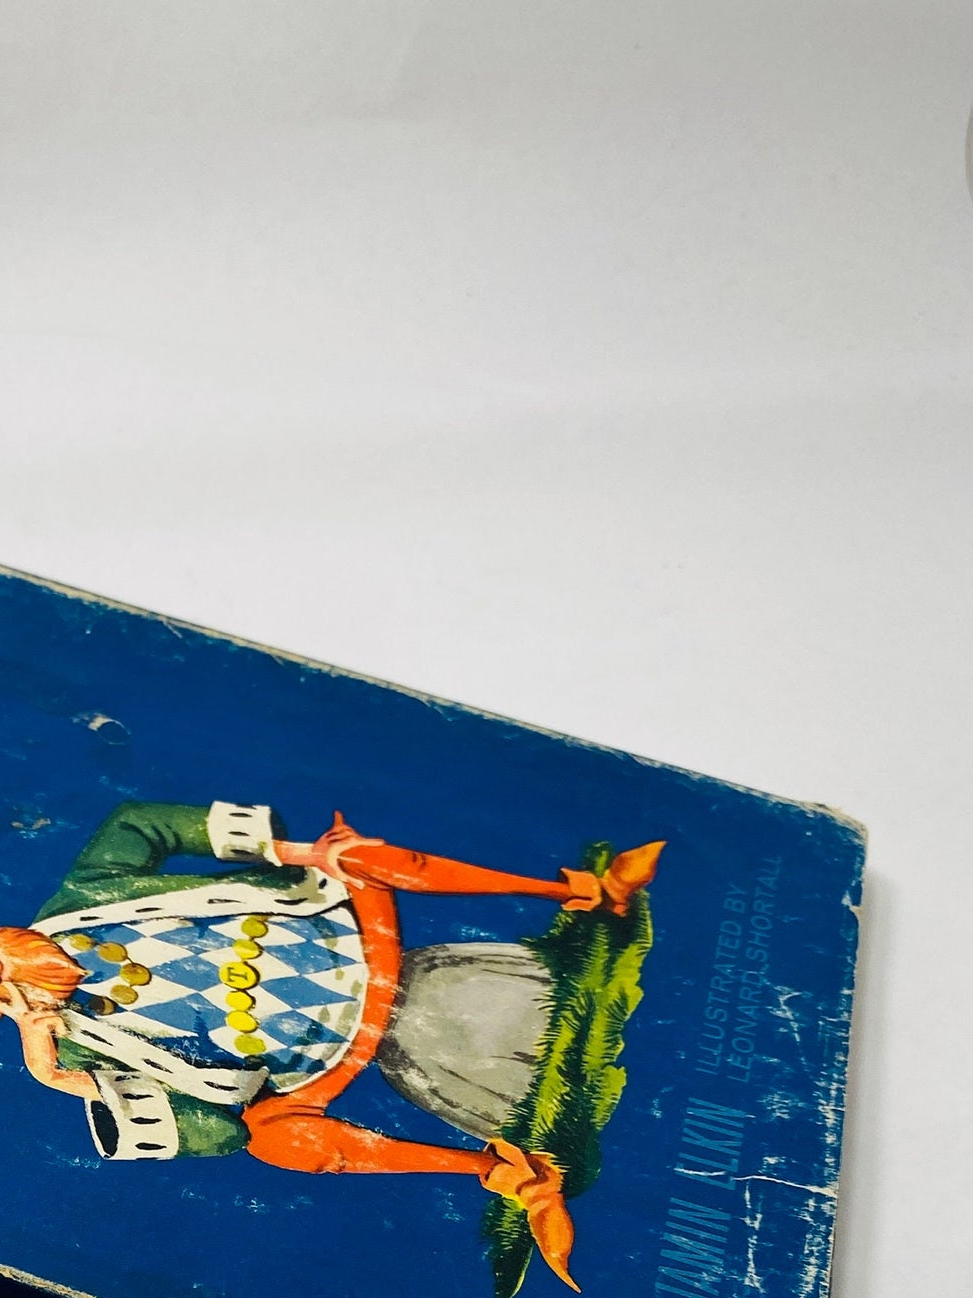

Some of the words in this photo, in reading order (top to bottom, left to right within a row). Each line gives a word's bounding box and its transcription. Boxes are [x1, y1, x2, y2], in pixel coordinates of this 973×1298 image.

[695, 919, 742, 1076] ILLUSTRATED
[723, 883, 747, 914] BY
[726, 971, 763, 1083] LEONARD
[745, 855, 782, 963] SHORTALL
